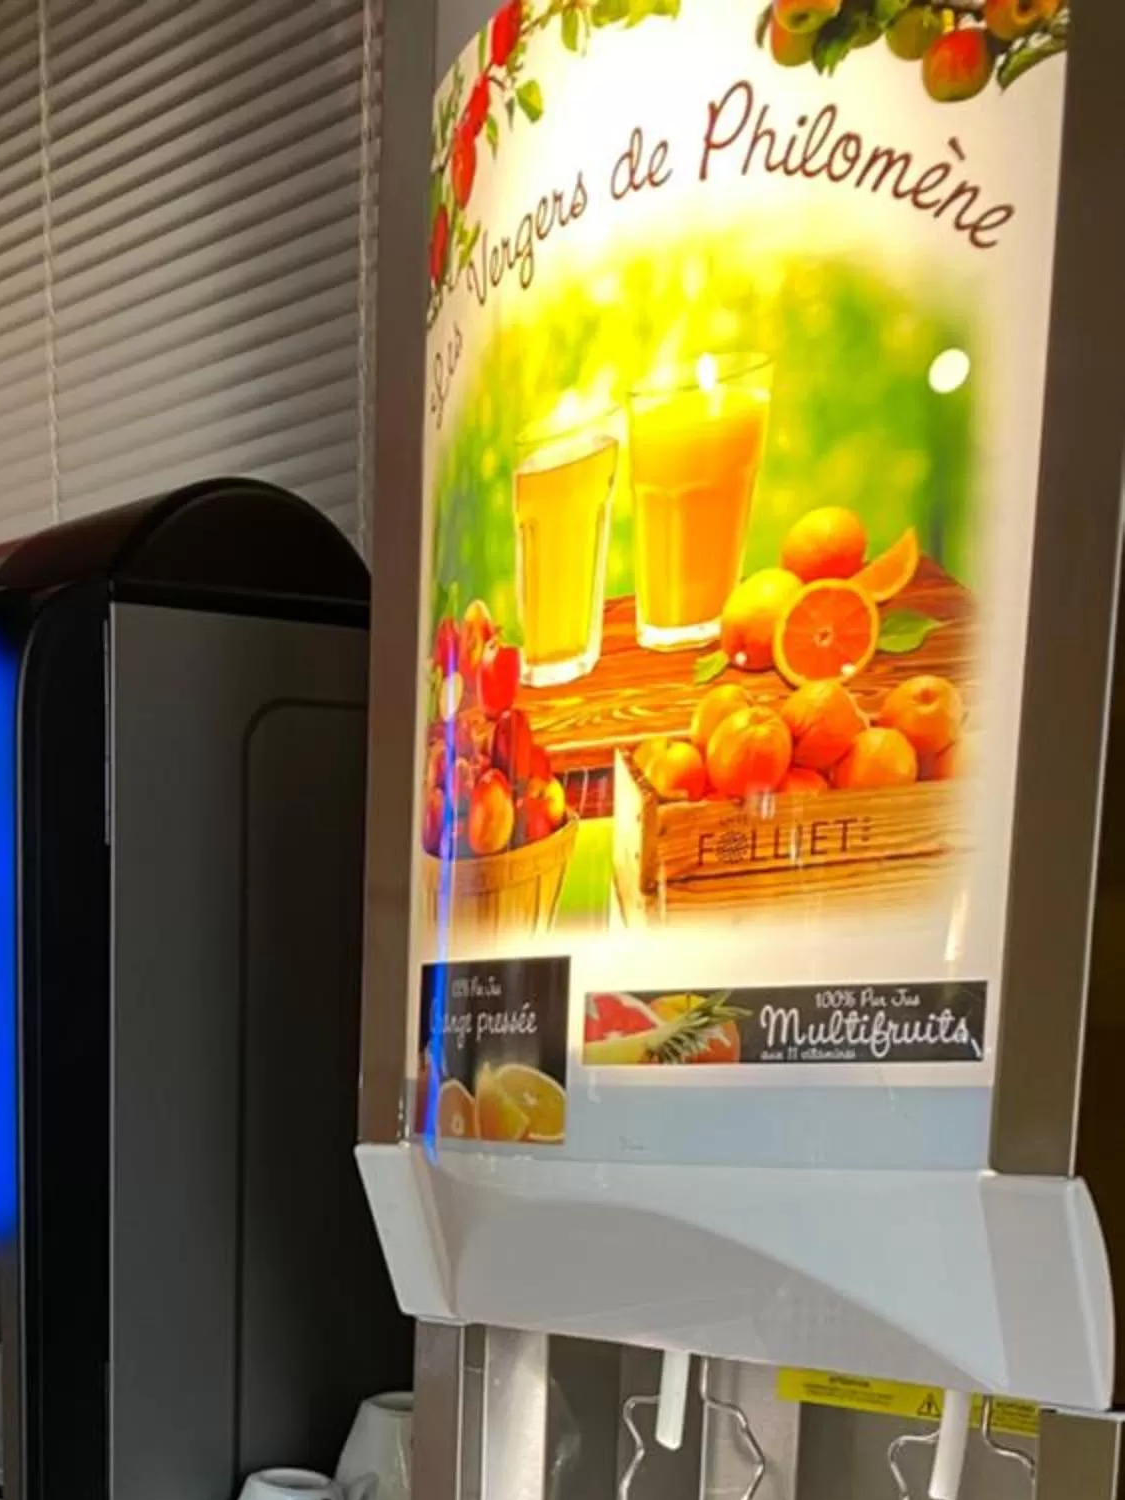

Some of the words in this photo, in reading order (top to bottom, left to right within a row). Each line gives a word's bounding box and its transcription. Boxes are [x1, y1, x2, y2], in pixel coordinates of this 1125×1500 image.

[466, 171, 588, 306] Vergers
[610, 127, 673, 202] de
[697, 79, 1015, 250] Philomène
[815, 989, 856, 1009] 100%
[859, 986, 888, 1008] Pur
[890, 988, 921, 1008] Jus
[477, 1002, 539, 1043] pressée
[759, 1004, 970, 1058] Multifruits
